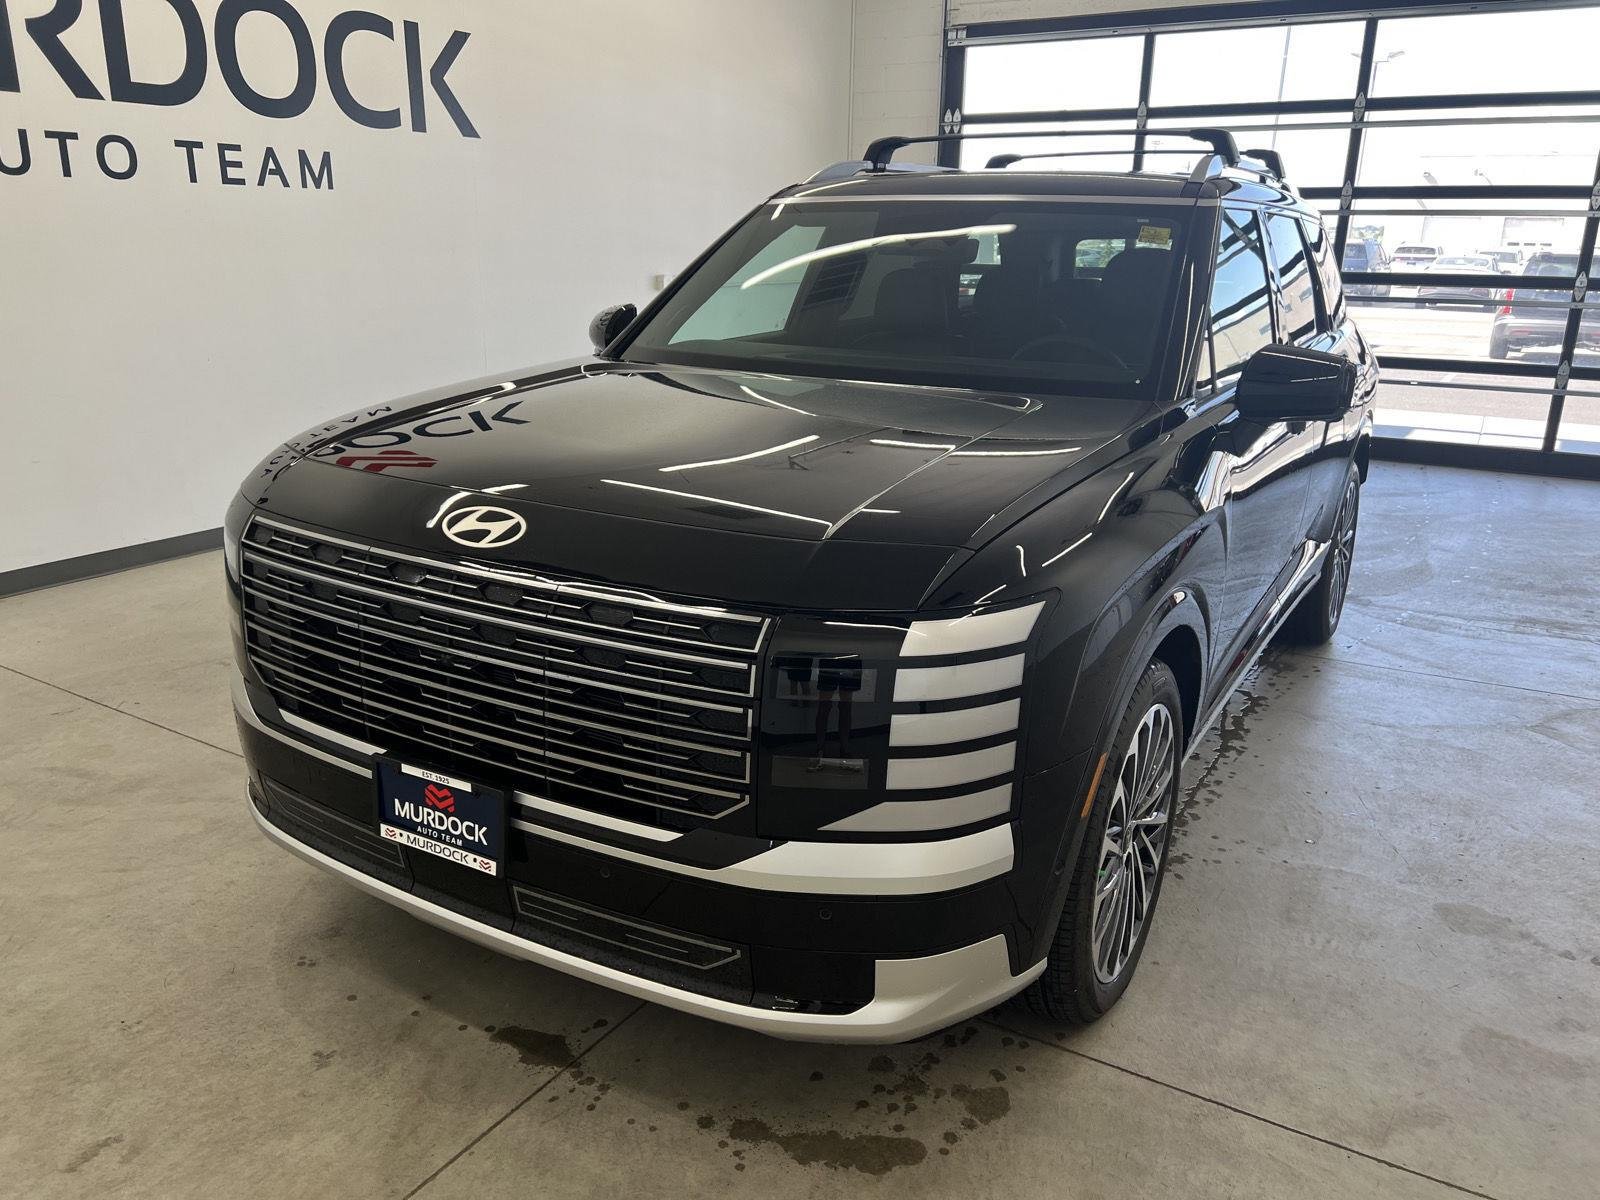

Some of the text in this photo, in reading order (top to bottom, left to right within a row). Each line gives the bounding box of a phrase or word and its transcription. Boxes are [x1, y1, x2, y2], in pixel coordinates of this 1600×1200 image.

[173, 139, 335, 190] TEAM
[421, 771, 450, 785] EST. 1925
[394, 798, 488, 846] MURDOCK
[416, 825, 463, 847] AUTO TEAM
[406, 833, 469, 864] MURDOCK
